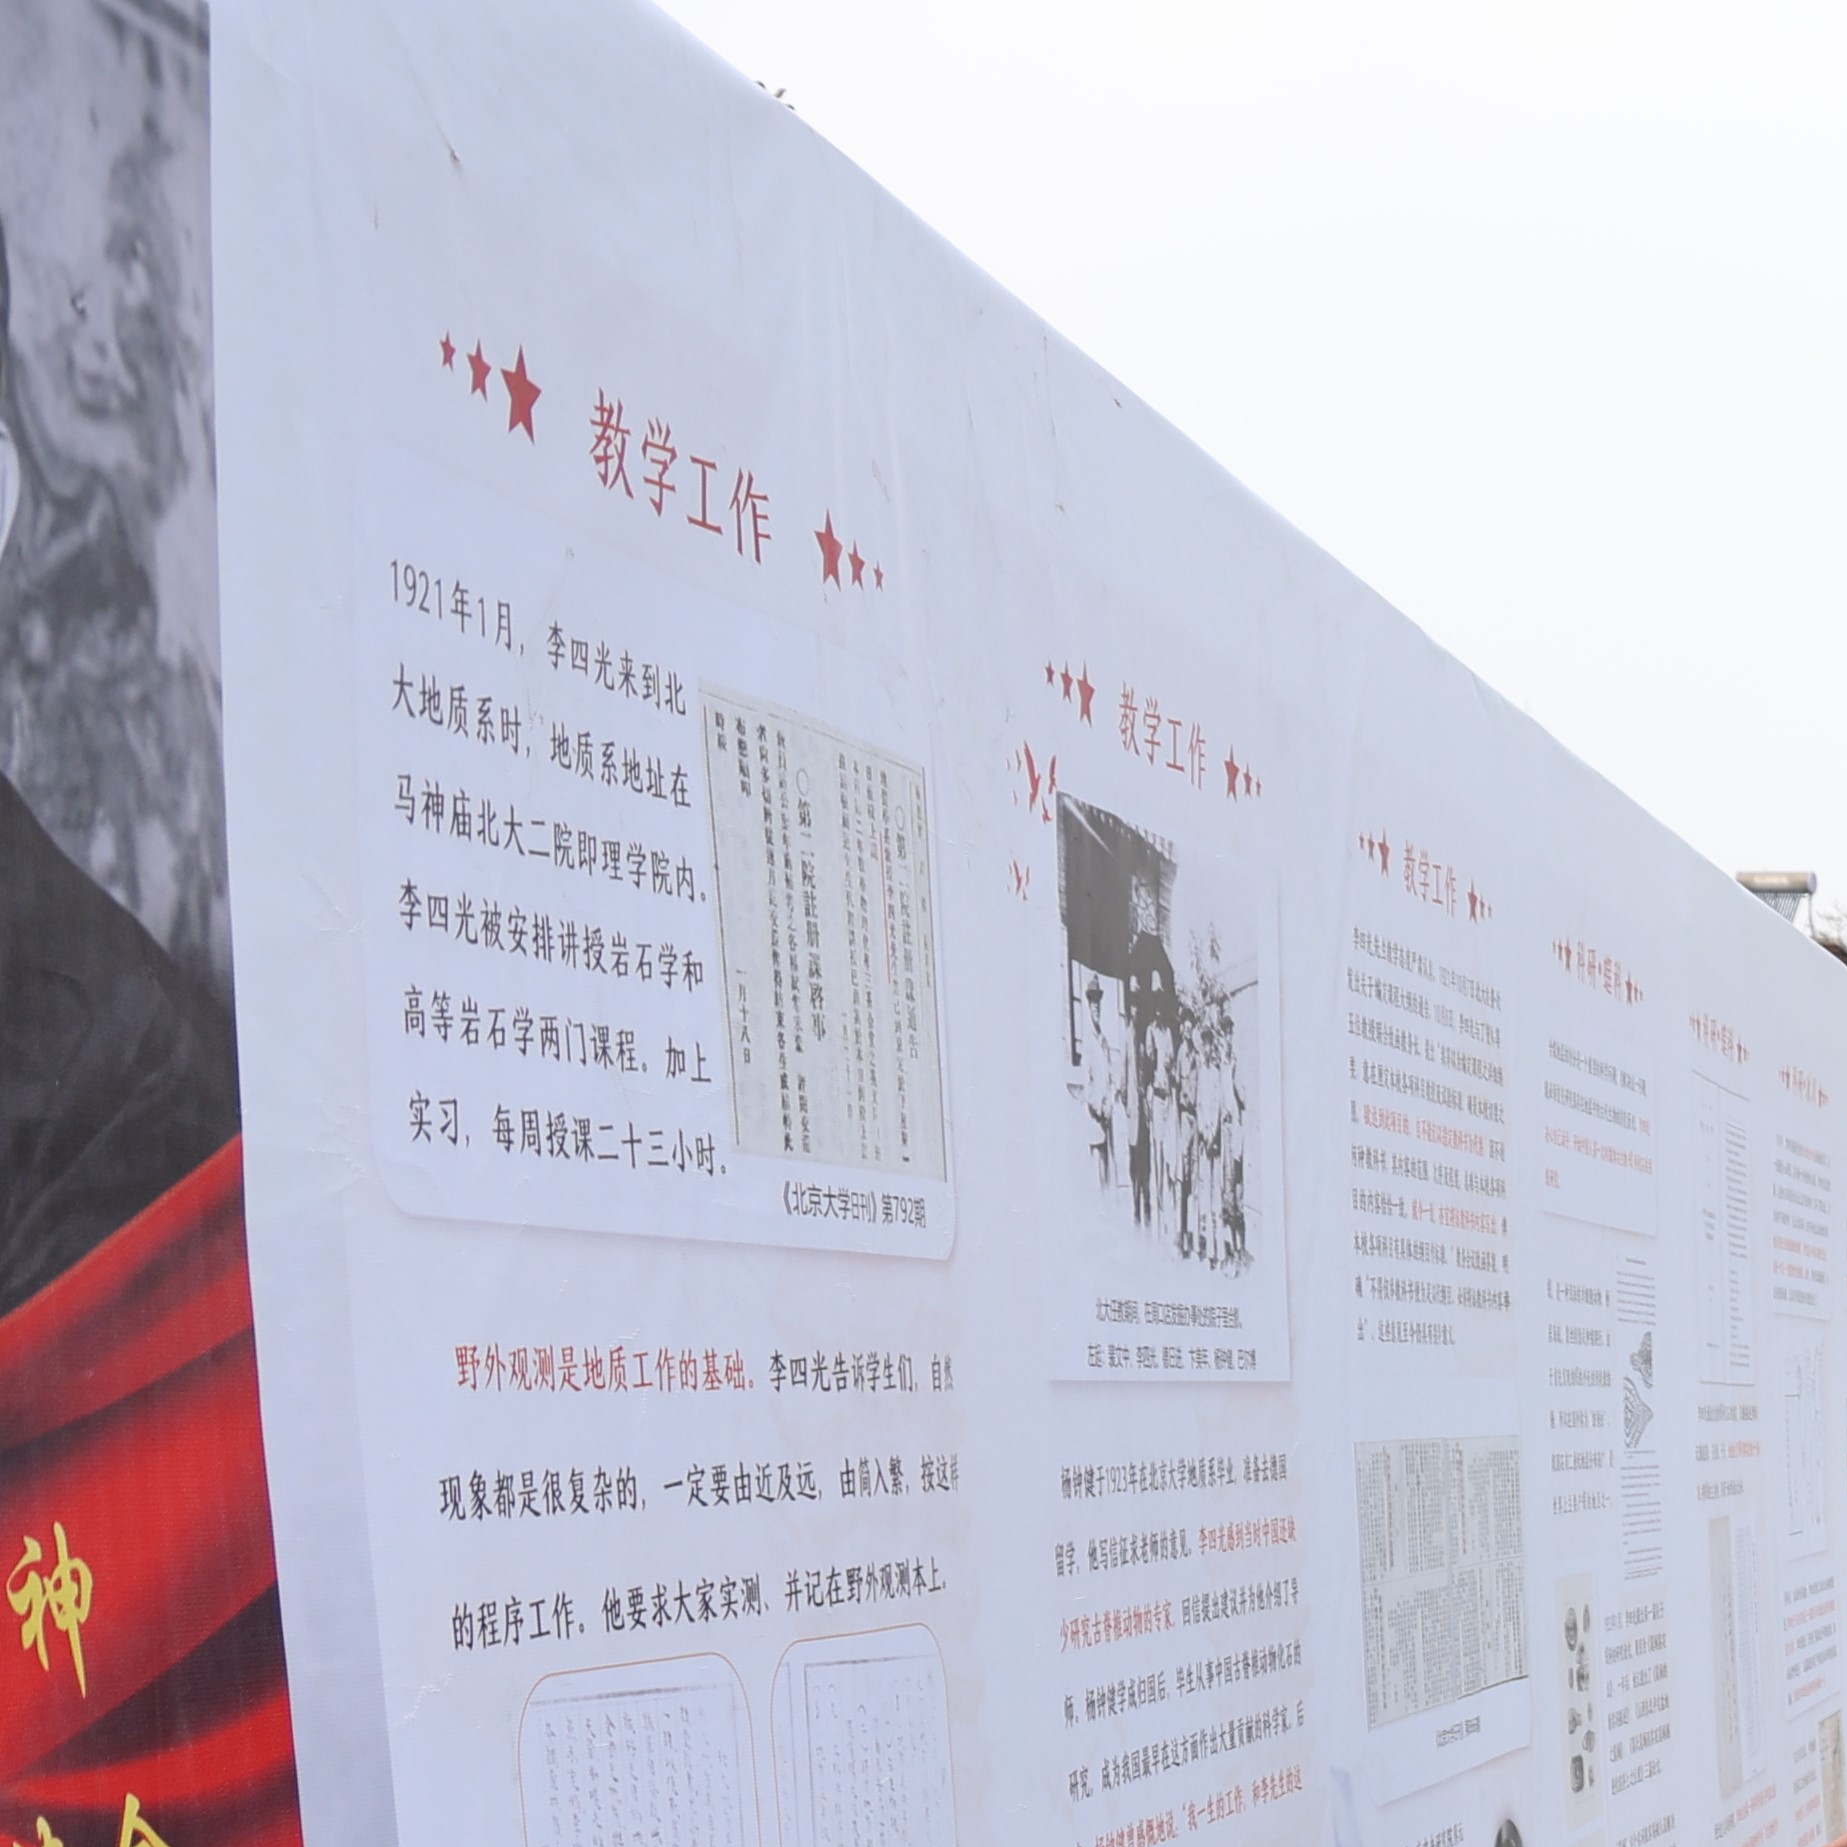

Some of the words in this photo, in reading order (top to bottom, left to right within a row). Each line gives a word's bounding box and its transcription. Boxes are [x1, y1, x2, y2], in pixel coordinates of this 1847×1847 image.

[588, 387, 774, 565] 教学工作
[1118, 680, 1206, 789] 教学工作
[398, 878, 705, 991] 李四光被安排讲授岩石学和
[403, 989, 713, 1085] 高等岩石学两门课程。加上
[8, 1522, 92, 1697] 神
